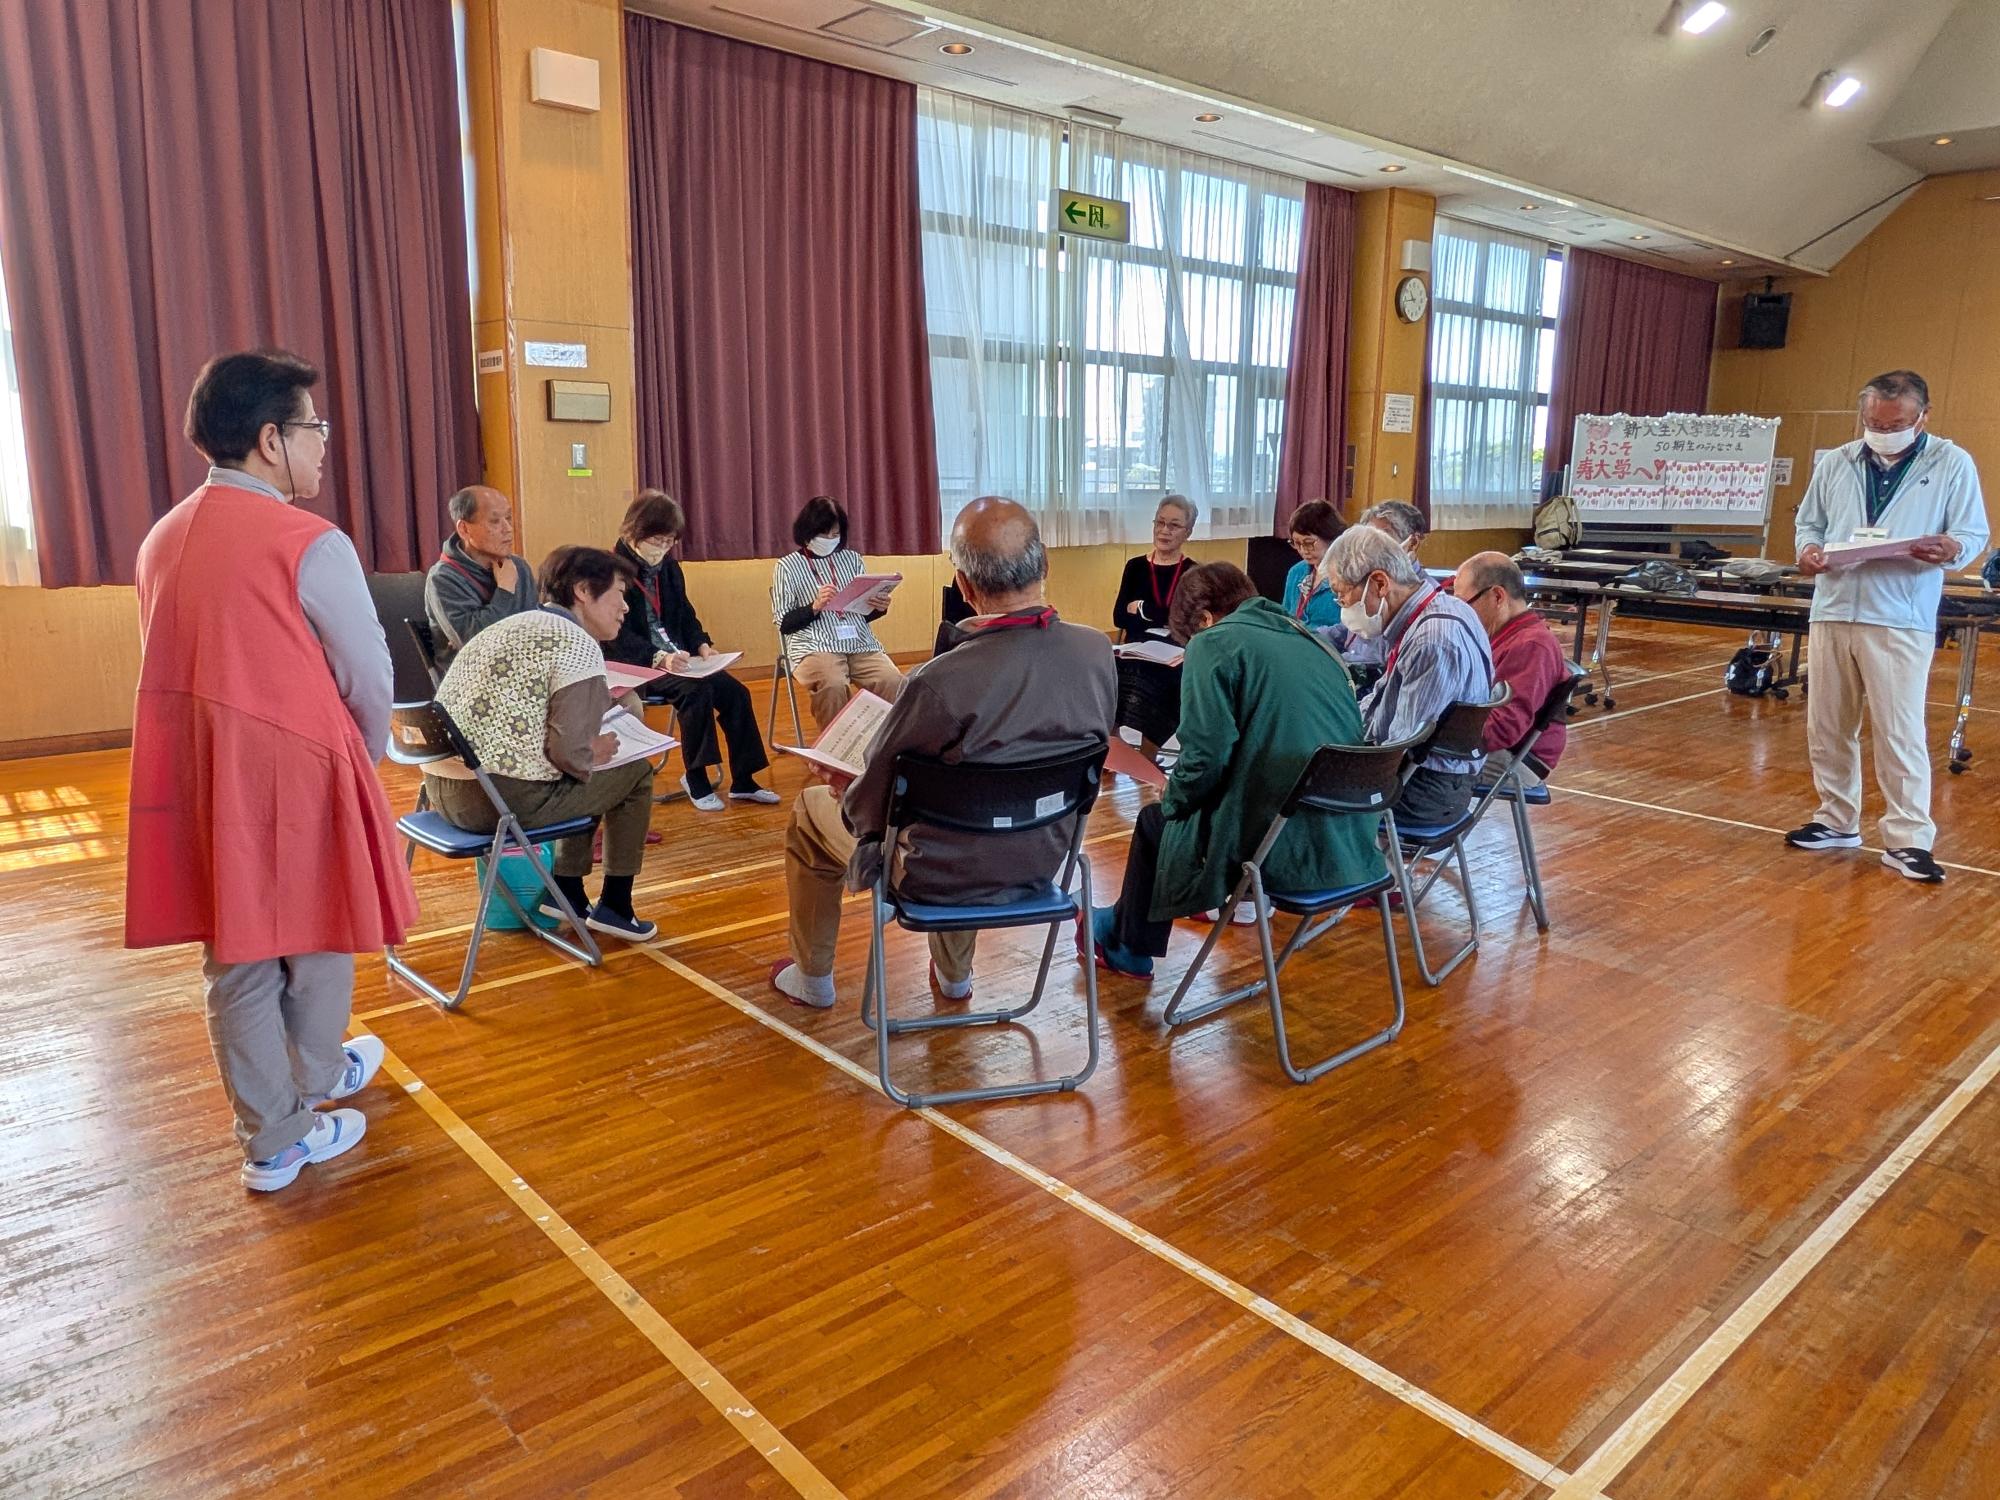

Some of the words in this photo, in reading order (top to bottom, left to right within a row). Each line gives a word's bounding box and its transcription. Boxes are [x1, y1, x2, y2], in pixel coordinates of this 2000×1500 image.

[1585, 440, 1632, 455] ようこそ
[1654, 439, 1743, 452] 50期生のみなさま
